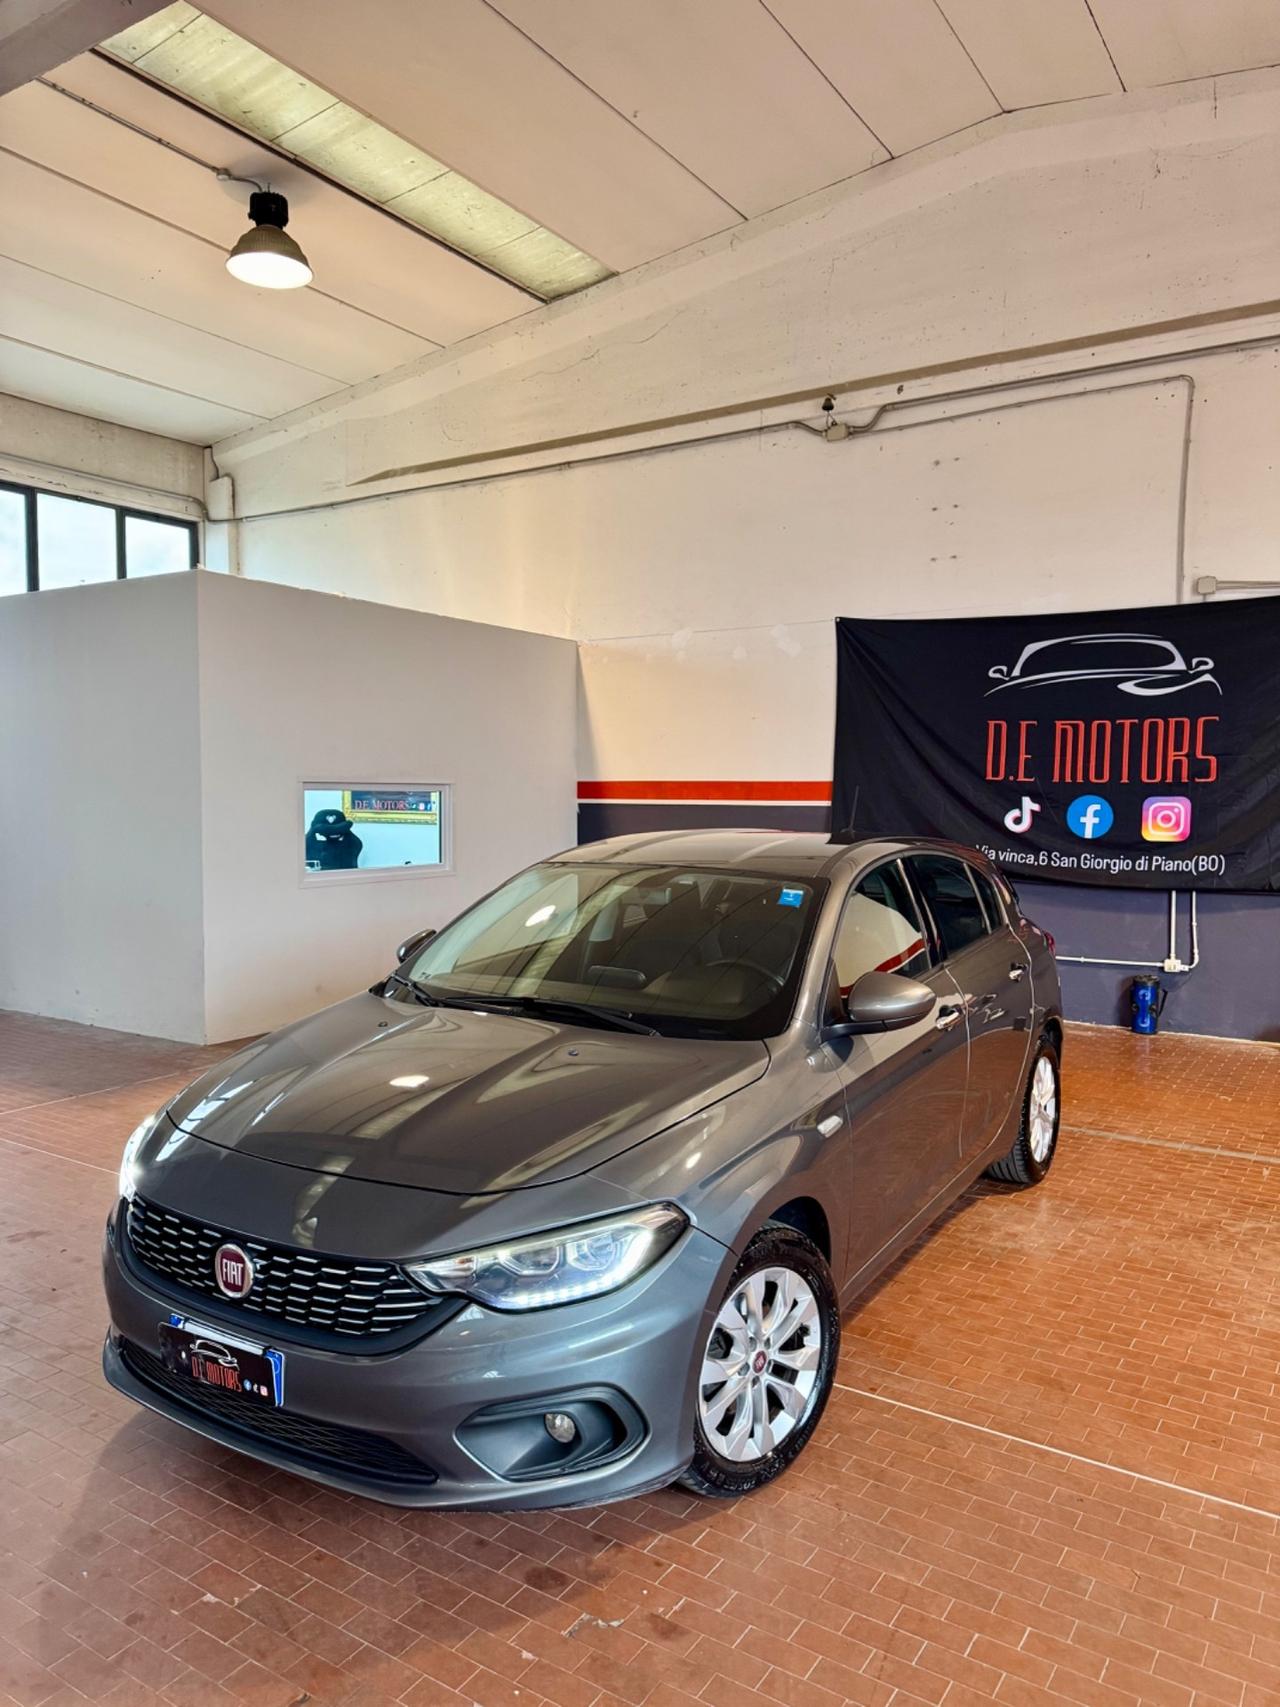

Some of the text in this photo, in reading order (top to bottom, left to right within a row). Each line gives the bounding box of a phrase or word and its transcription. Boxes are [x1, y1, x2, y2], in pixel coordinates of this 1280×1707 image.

[985, 716, 1220, 783] D.E MOTORS
[1050, 851, 1078, 869] San
[1080, 853, 1133, 875] Giorgio
[1135, 855, 1149, 871] di
[1151, 854, 1226, 876] Piano(BO)
[222, 1258, 244, 1286] FIAT
